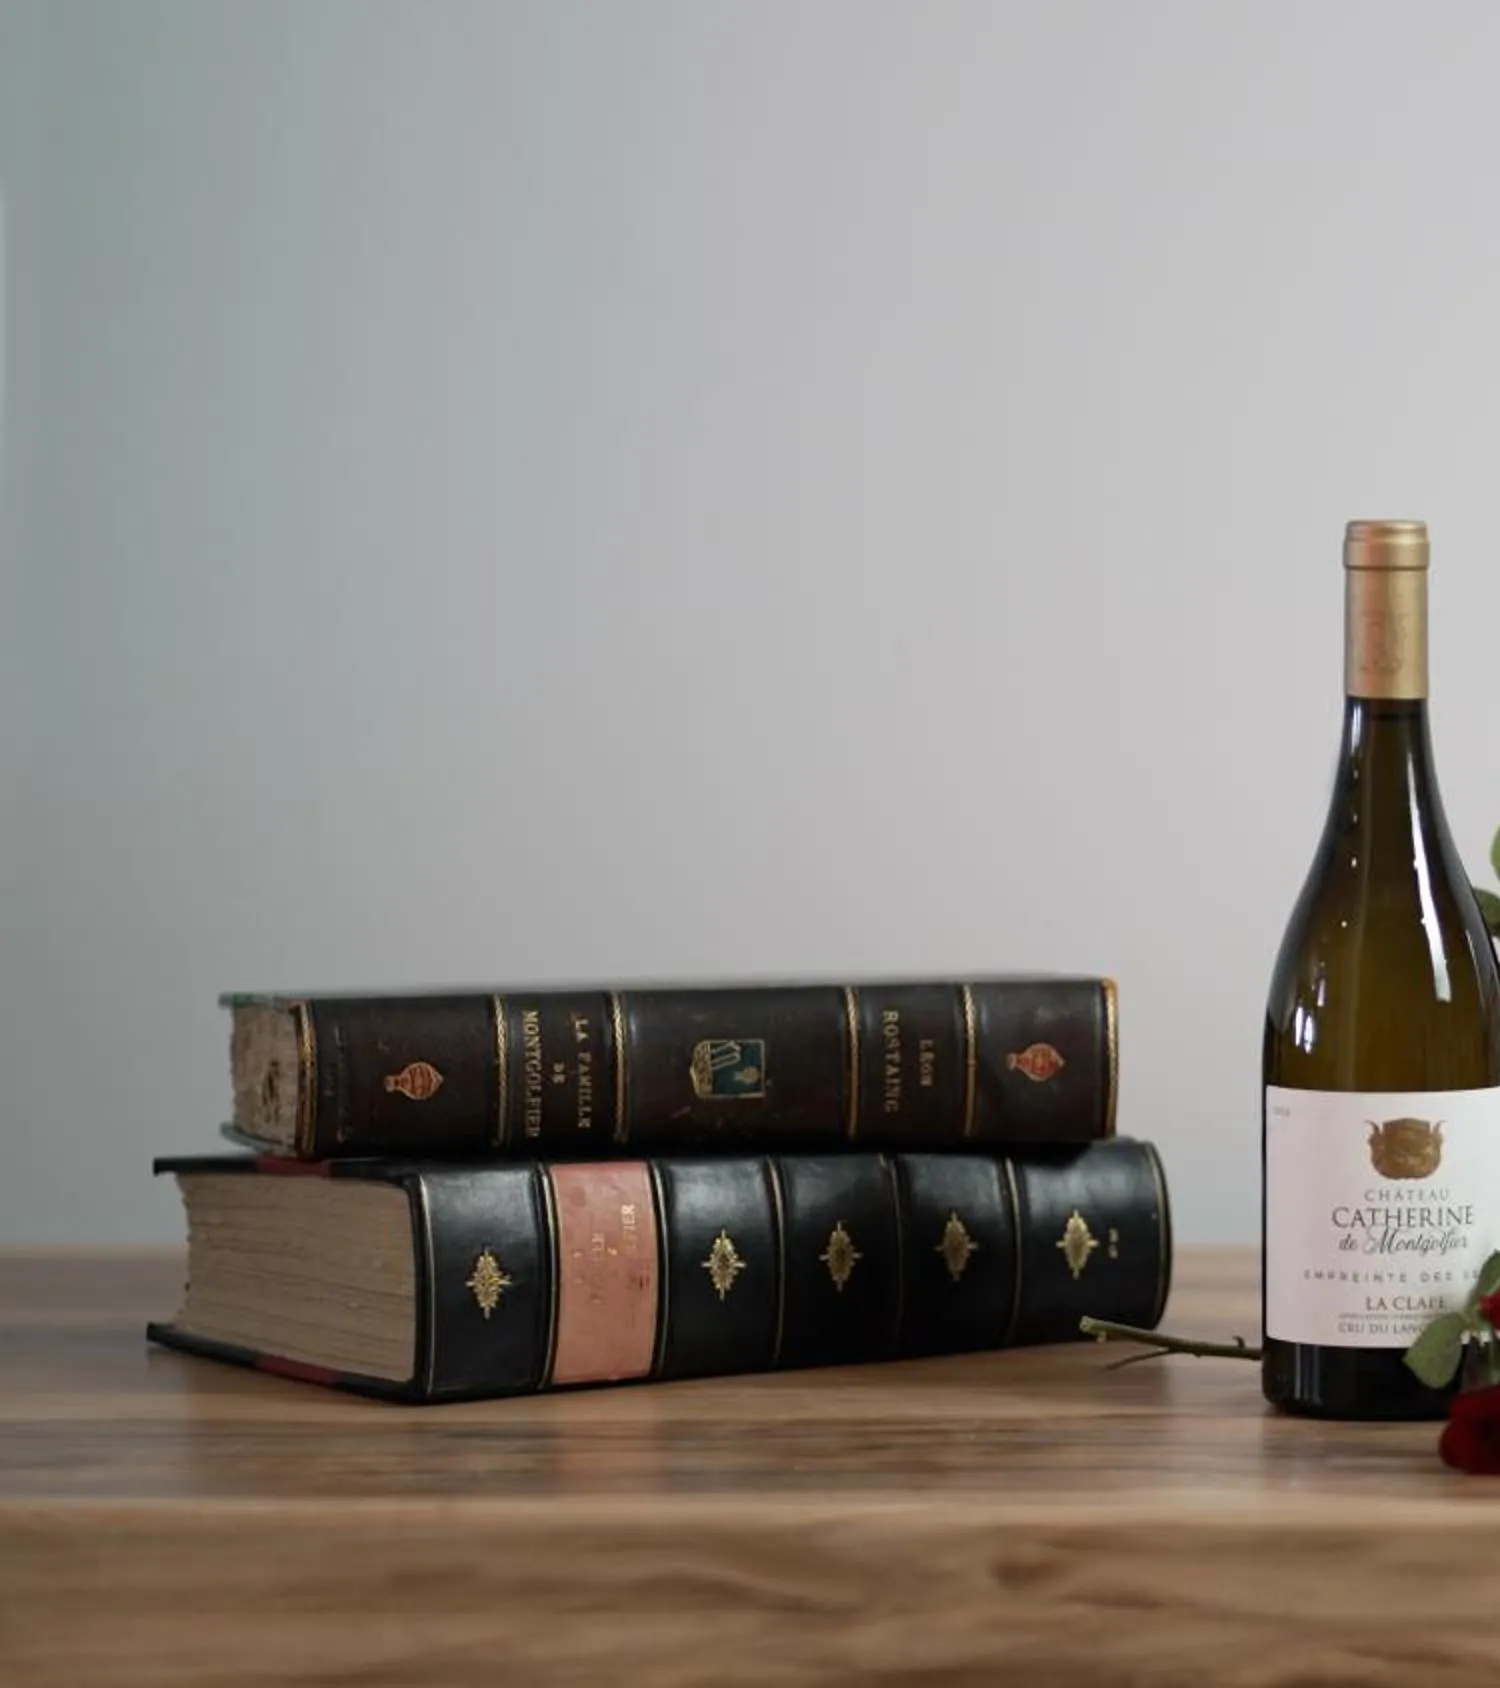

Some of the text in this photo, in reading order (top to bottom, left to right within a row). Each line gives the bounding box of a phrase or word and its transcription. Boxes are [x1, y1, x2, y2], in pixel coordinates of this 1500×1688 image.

[522, 1011, 542, 1137] MONTGOLFIER
[575, 1020, 592, 1128] LA FAMILLE
[884, 1010, 901, 1112] ROSTAING
[1331, 1205, 1473, 1228] CATHERINE
[1339, 1227, 1467, 1255] de Montgolfier
[1366, 1296, 1387, 1311] LA
